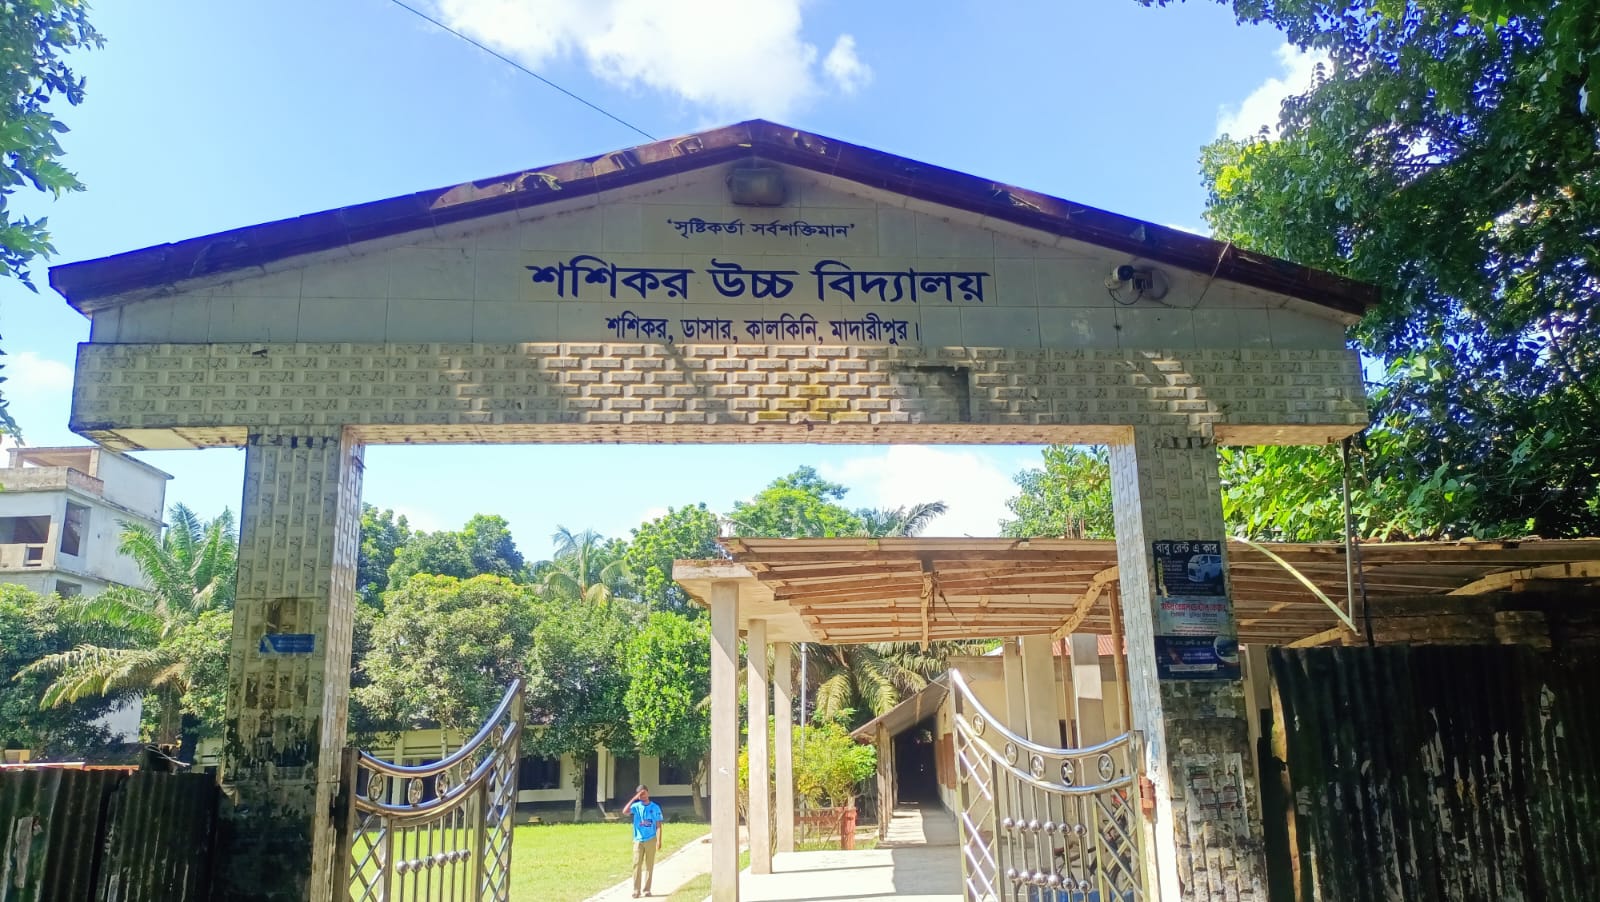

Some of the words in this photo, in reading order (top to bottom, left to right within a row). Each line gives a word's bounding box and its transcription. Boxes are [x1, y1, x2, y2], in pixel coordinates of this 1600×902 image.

[526, 255, 694, 299] শশিকর
[705, 258, 801, 300] উচ্চ
[811, 260, 990, 303] বিদ্যালয়
[605, 310, 674, 345] শশিকর,
[680, 316, 738, 343] ডাসার,
[744, 313, 824, 345] কালকিনি,
[1156, 543, 1171, 556] বাবু
[1192, 543, 1200, 553] এ
